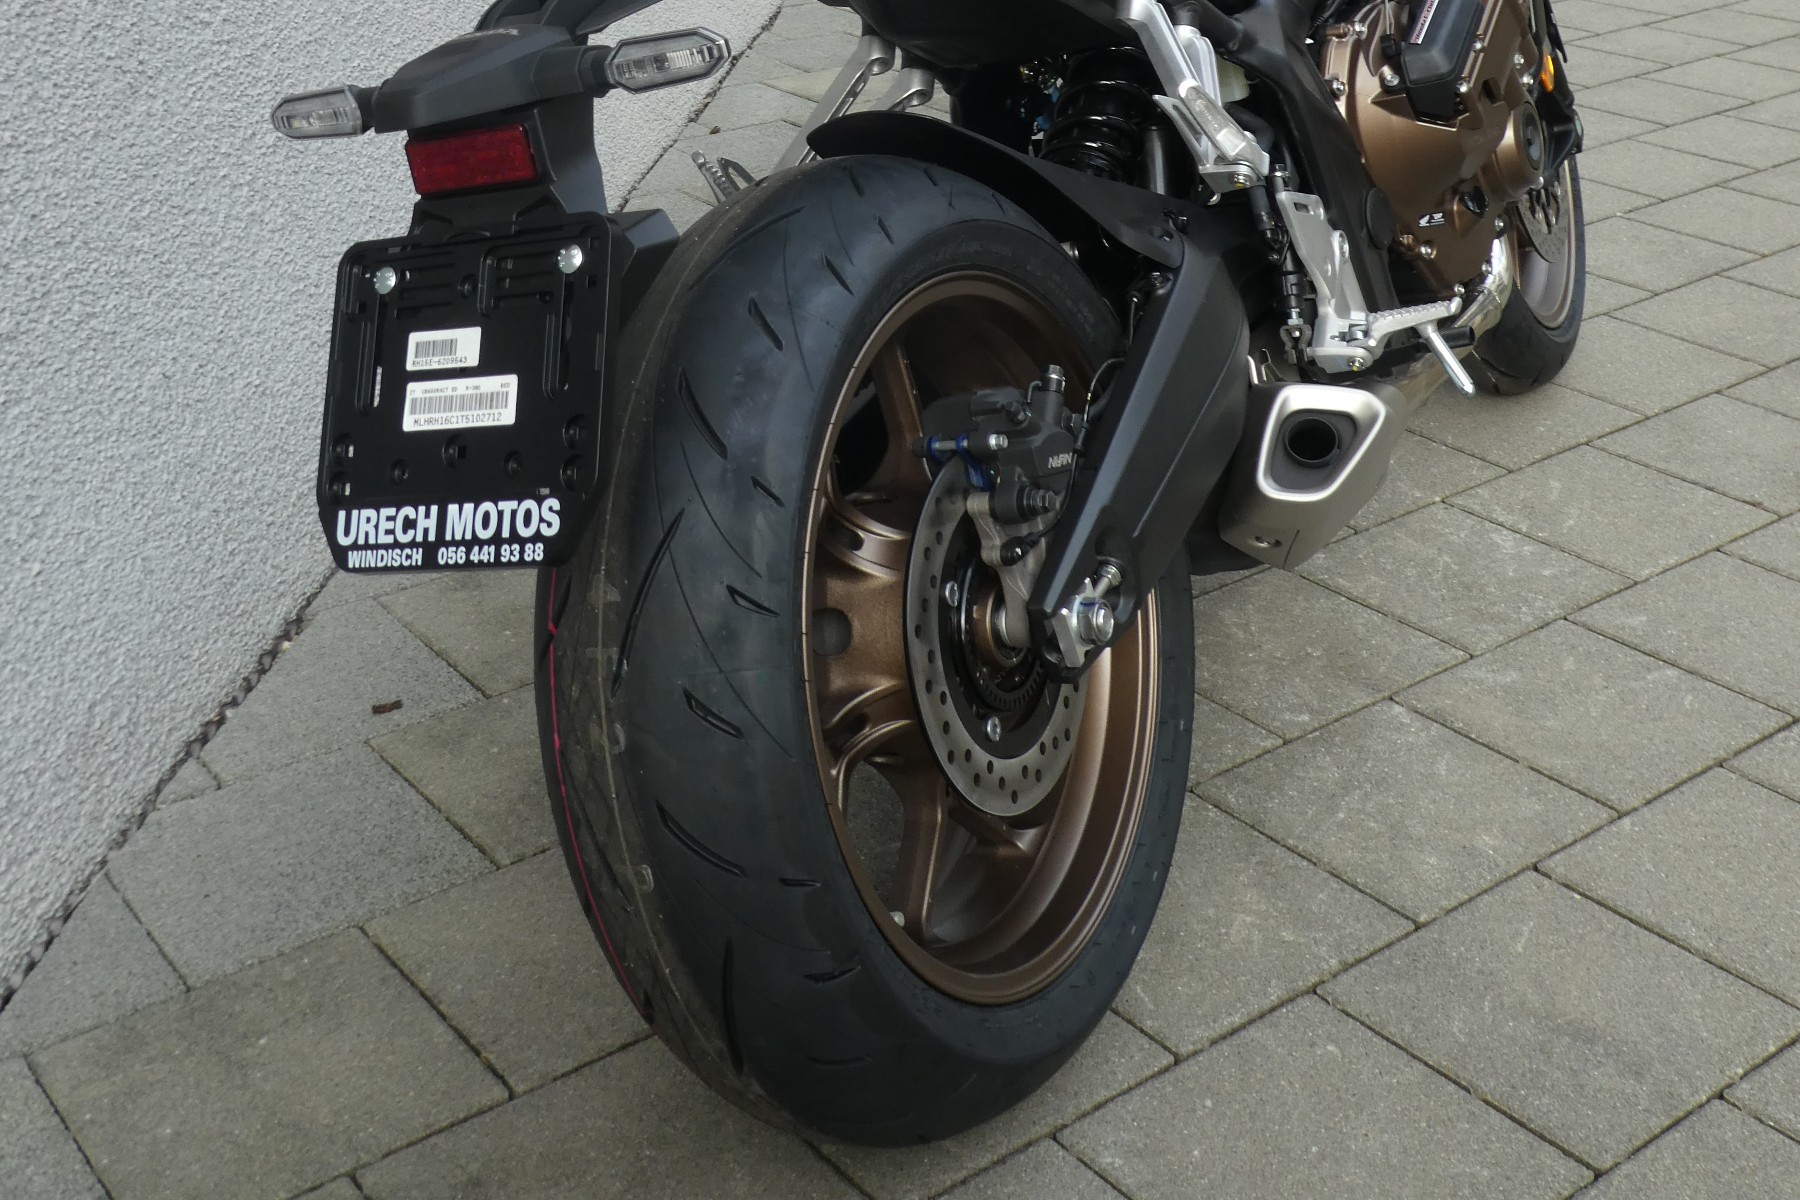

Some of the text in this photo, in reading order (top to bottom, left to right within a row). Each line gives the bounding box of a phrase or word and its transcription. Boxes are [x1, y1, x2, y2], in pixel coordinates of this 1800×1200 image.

[336, 498, 561, 546] URECH MOTOS
[348, 542, 544, 569] WINDISCH 056 441 93 88
